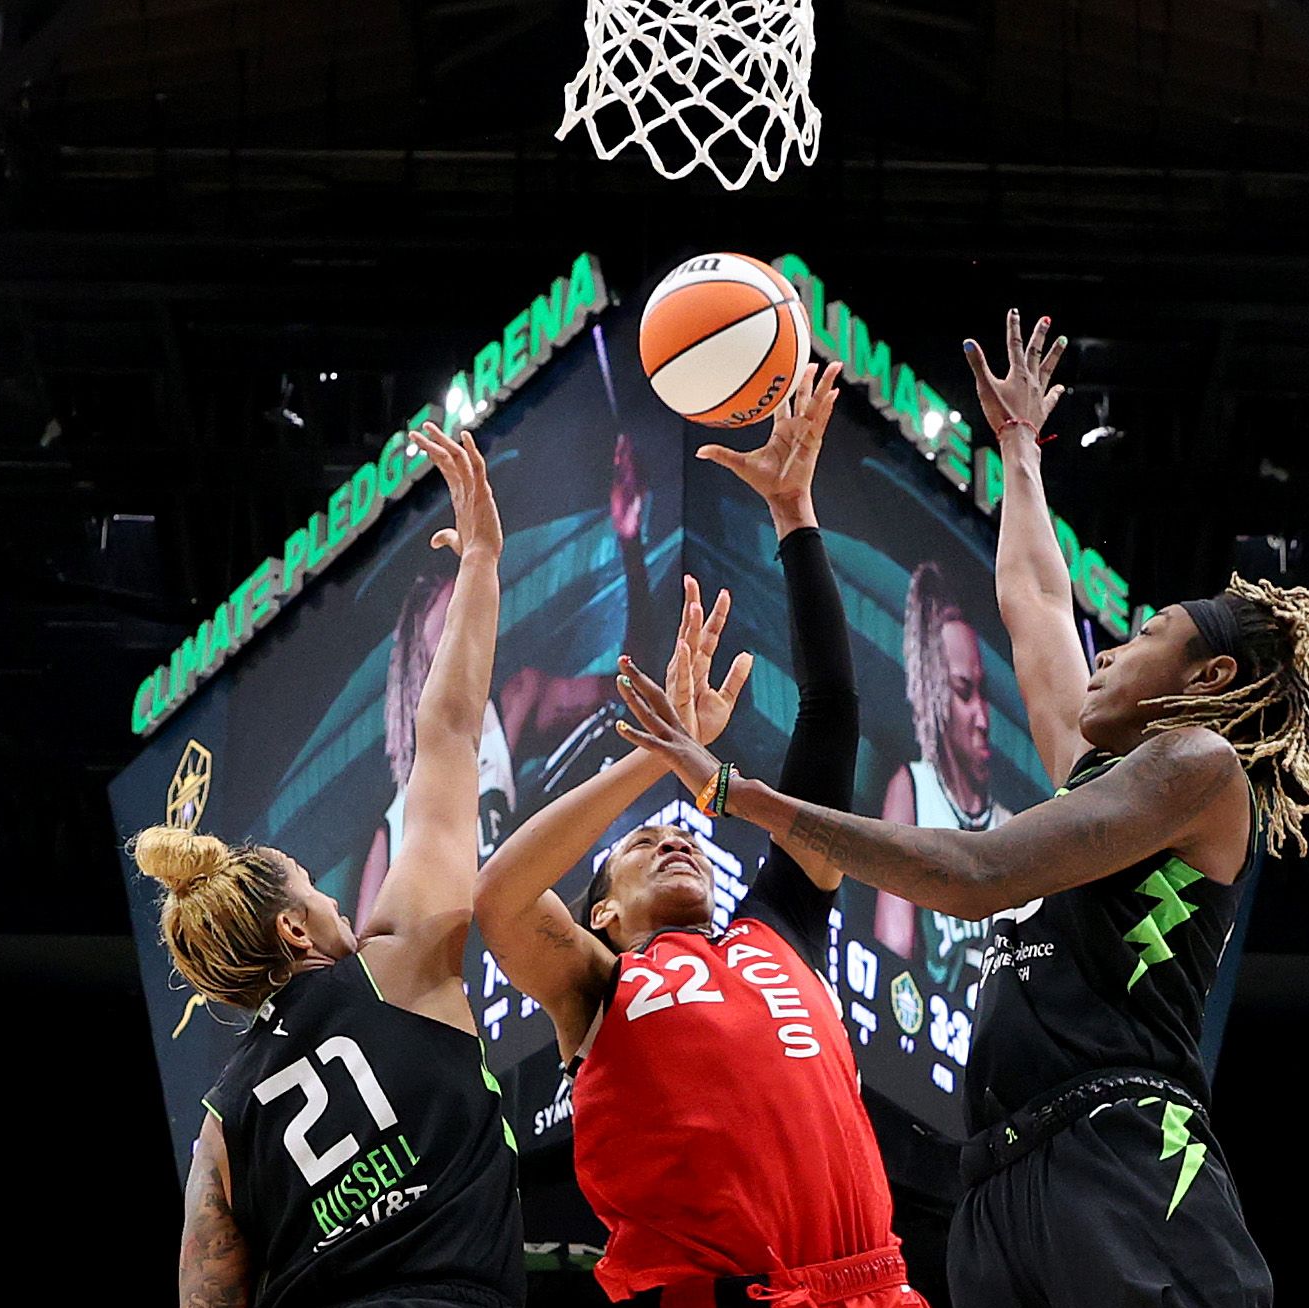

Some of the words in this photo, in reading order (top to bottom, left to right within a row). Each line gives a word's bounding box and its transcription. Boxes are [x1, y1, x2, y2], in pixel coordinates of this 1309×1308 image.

[131, 557, 283, 735] CLIMATE
[283, 404, 433, 592] PLEDGE
[442, 252, 600, 438] ARENA
[620, 955, 725, 1022] 22
[727, 942, 821, 1058] ACES
[847, 940, 878, 1000] 67
[253, 1035, 398, 1187] 21
[311, 1134, 420, 1235] RUSSELL
